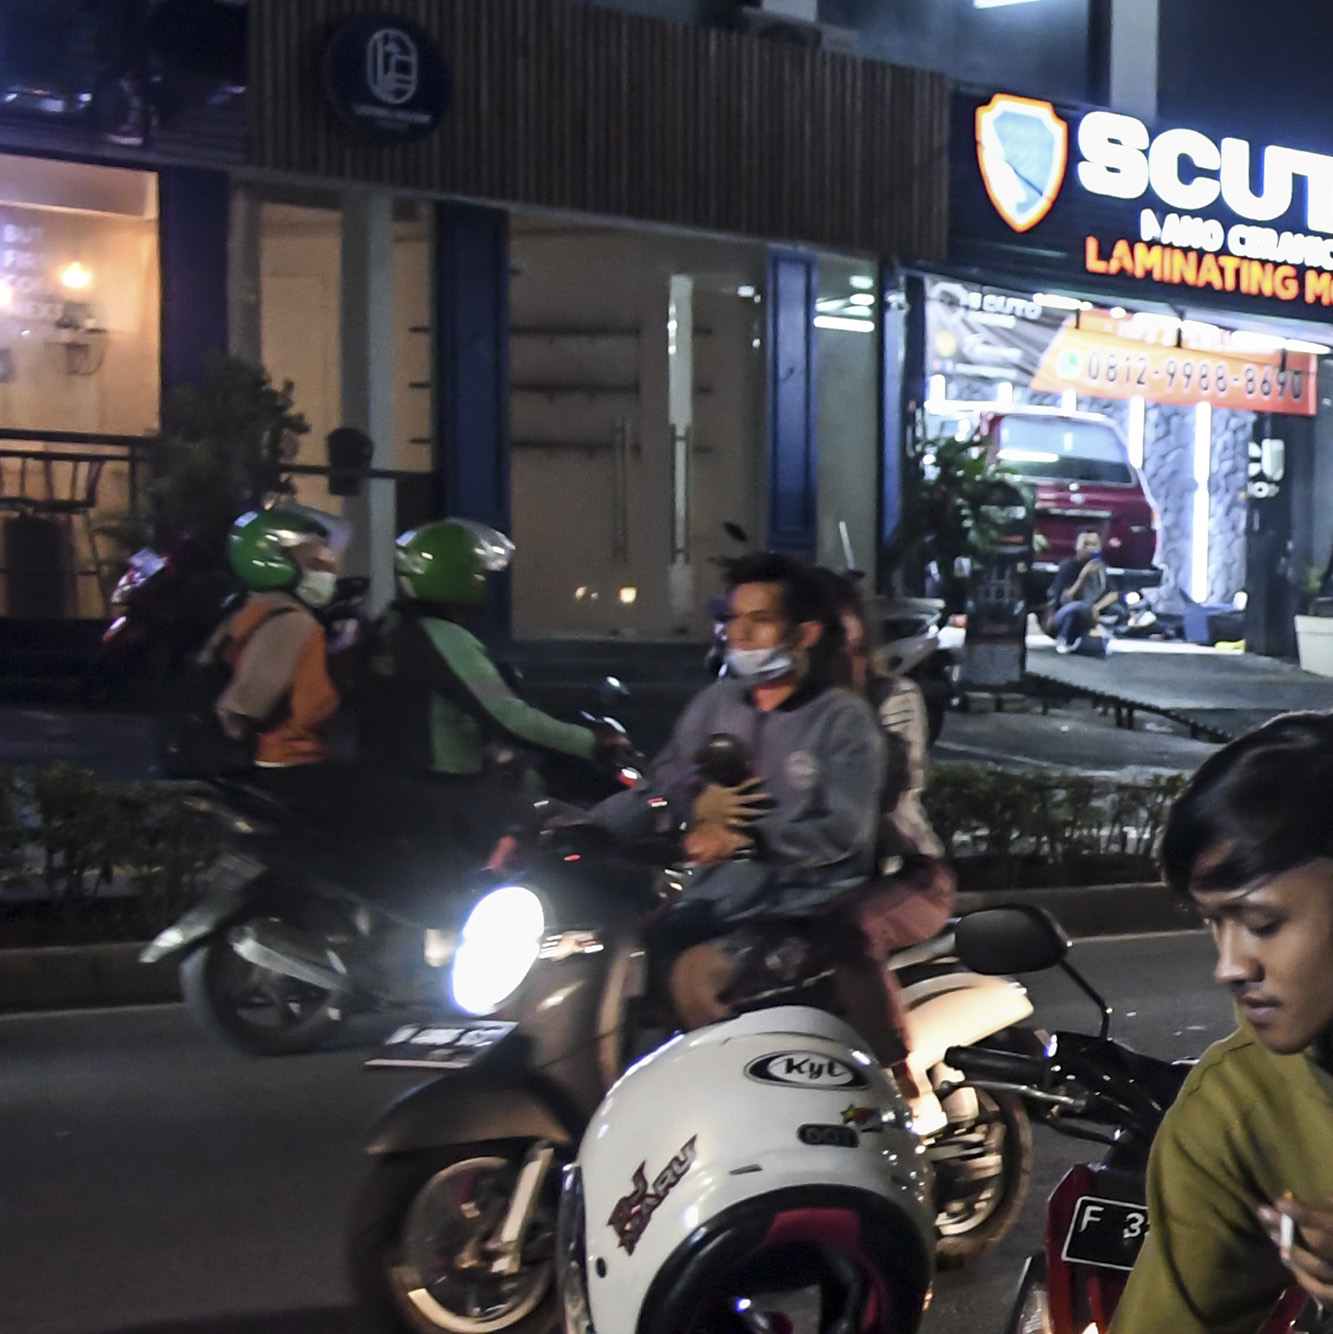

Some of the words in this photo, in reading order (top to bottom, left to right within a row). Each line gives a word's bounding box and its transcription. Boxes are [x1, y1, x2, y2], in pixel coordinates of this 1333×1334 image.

[1085, 234, 1300, 301] LAMINATING
[1086, 349, 1305, 401] 0812-9988-8690
[1079, 1204, 1106, 1233] F
